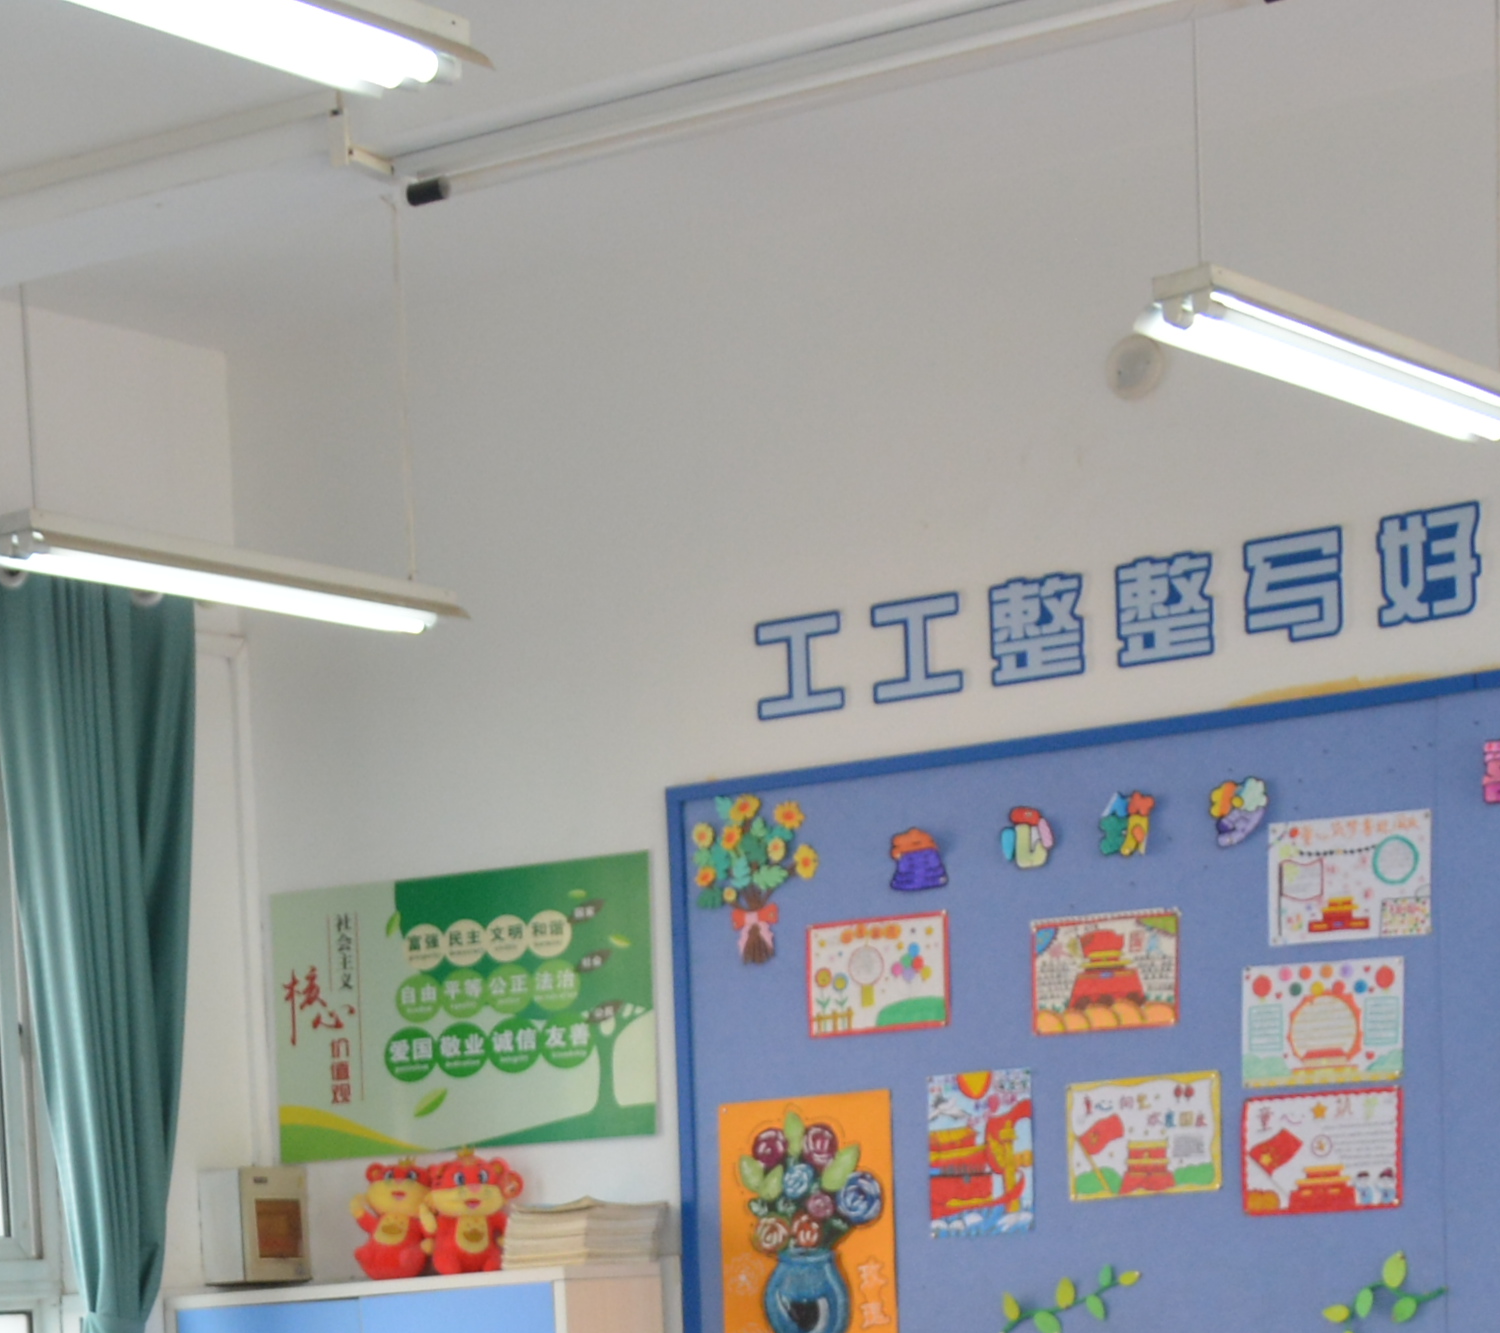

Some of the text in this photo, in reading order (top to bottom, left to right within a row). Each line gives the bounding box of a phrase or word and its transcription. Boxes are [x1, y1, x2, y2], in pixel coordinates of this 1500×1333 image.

[335, 912, 353, 991] 社会主义
[408, 932, 441, 952] 富强
[448, 928, 482, 947] 民主
[489, 924, 524, 942] 文明
[531, 919, 565, 938] 和谐
[281, 964, 356, 1047] 核心
[401, 984, 438, 1005] 自由
[443, 977, 484, 1000] 平等
[488, 972, 528, 995] 公正
[535, 968, 576, 991] 法治
[389, 1036, 433, 1063] 爱国
[439, 1033, 485, 1058] 敬业
[491, 1028, 537, 1053] 诚信
[544, 1022, 591, 1047] 友善
[330, 1036, 352, 1105] 价值观
